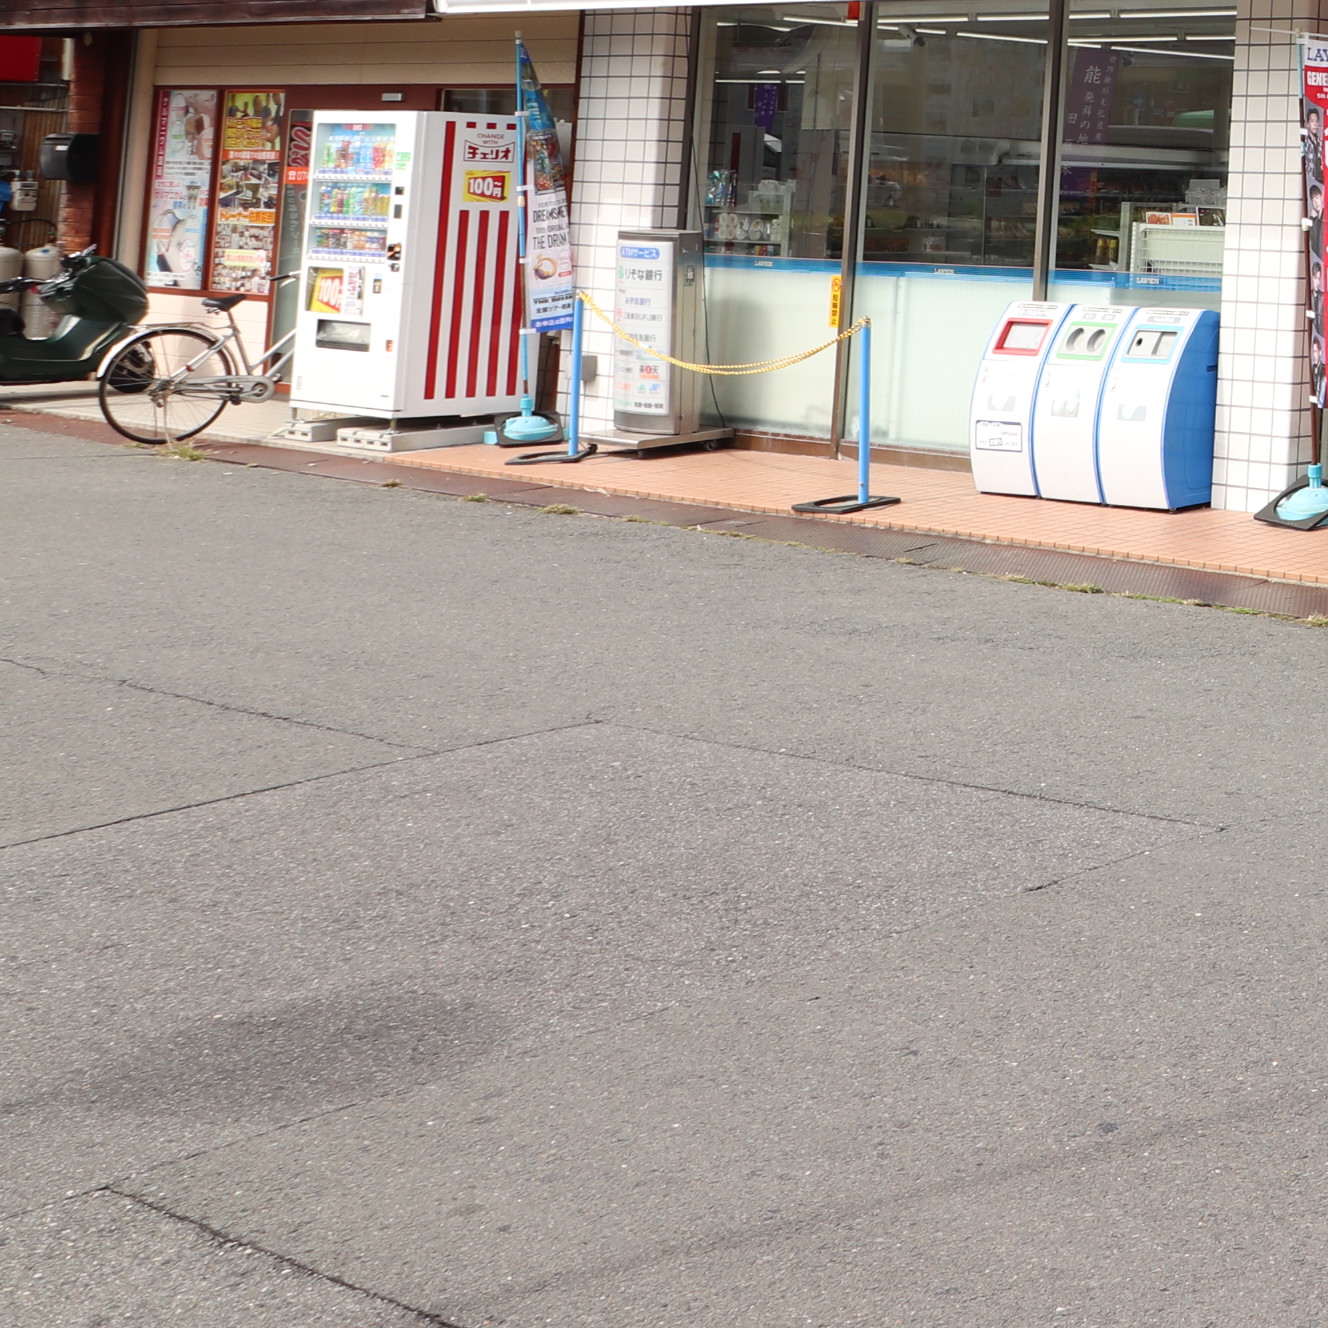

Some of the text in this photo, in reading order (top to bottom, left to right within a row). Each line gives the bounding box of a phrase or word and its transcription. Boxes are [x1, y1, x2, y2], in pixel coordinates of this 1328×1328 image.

[467, 145, 511, 160] チェリオ
[625, 268, 663, 281] りそな銀行
